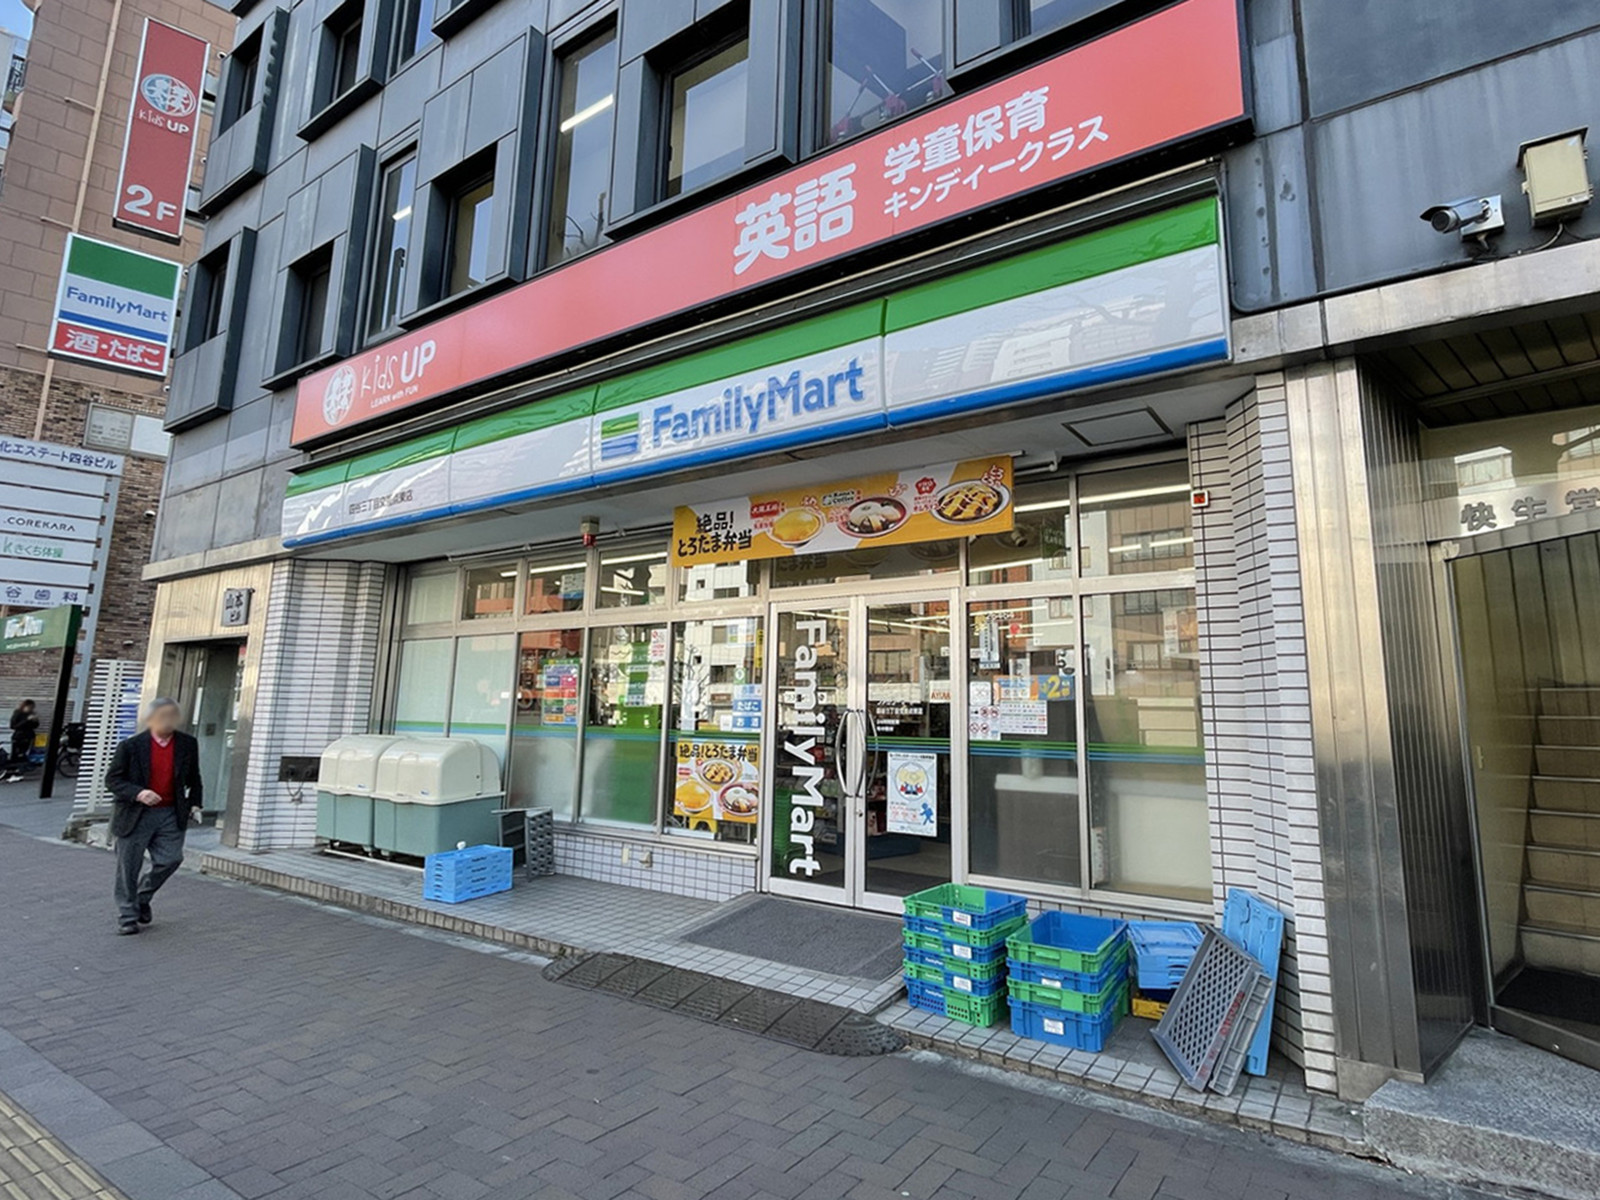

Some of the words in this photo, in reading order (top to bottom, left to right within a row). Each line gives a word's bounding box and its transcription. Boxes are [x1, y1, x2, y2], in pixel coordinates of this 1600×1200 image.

[167, 119, 190, 134] UP
[884, 86, 1050, 185] 学童保育
[884, 115, 1110, 219] キンディークラス
[124, 184, 178, 221] 2F
[733, 162, 858, 276] 英語
[66, 286, 169, 323] FamilyMart
[65, 328, 160, 367] 酒・たばこ
[400, 339, 437, 383] UP
[653, 357, 865, 448] FamilyMart
[678, 529, 752, 558] とろたま弁当
[736, 701, 760, 712] たばこ
[784, 620, 828, 877] FamilyMart
